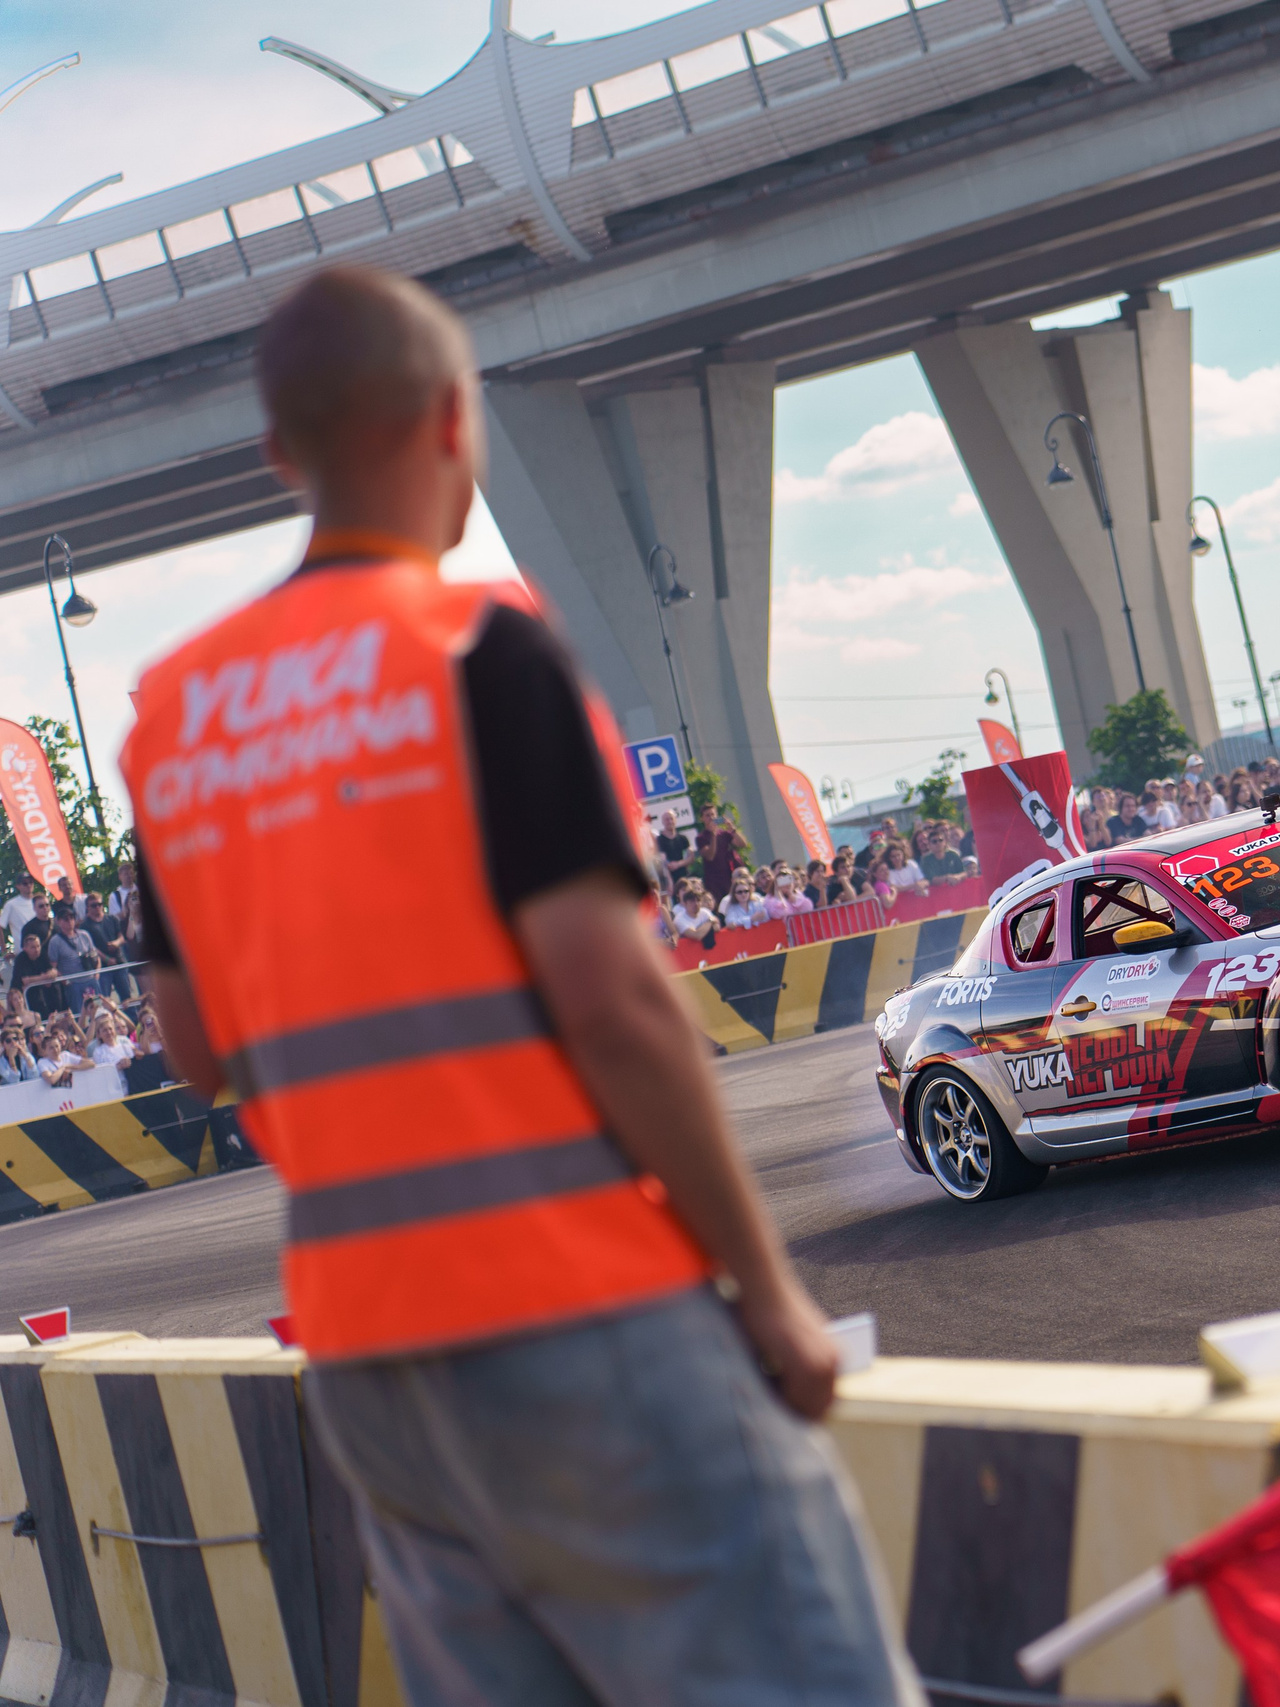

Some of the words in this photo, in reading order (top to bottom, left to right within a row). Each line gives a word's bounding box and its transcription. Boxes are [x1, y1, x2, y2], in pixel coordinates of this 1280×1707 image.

[178, 620, 386, 748] YUKA
[637, 745, 670, 793] P
[1233, 839, 1268, 855] YUKA
[1192, 856, 1280, 898] 123
[936, 976, 998, 1009] FORTIS
[1108, 963, 1148, 981] DRYDRY
[1006, 1051, 1075, 1092] YUKA
